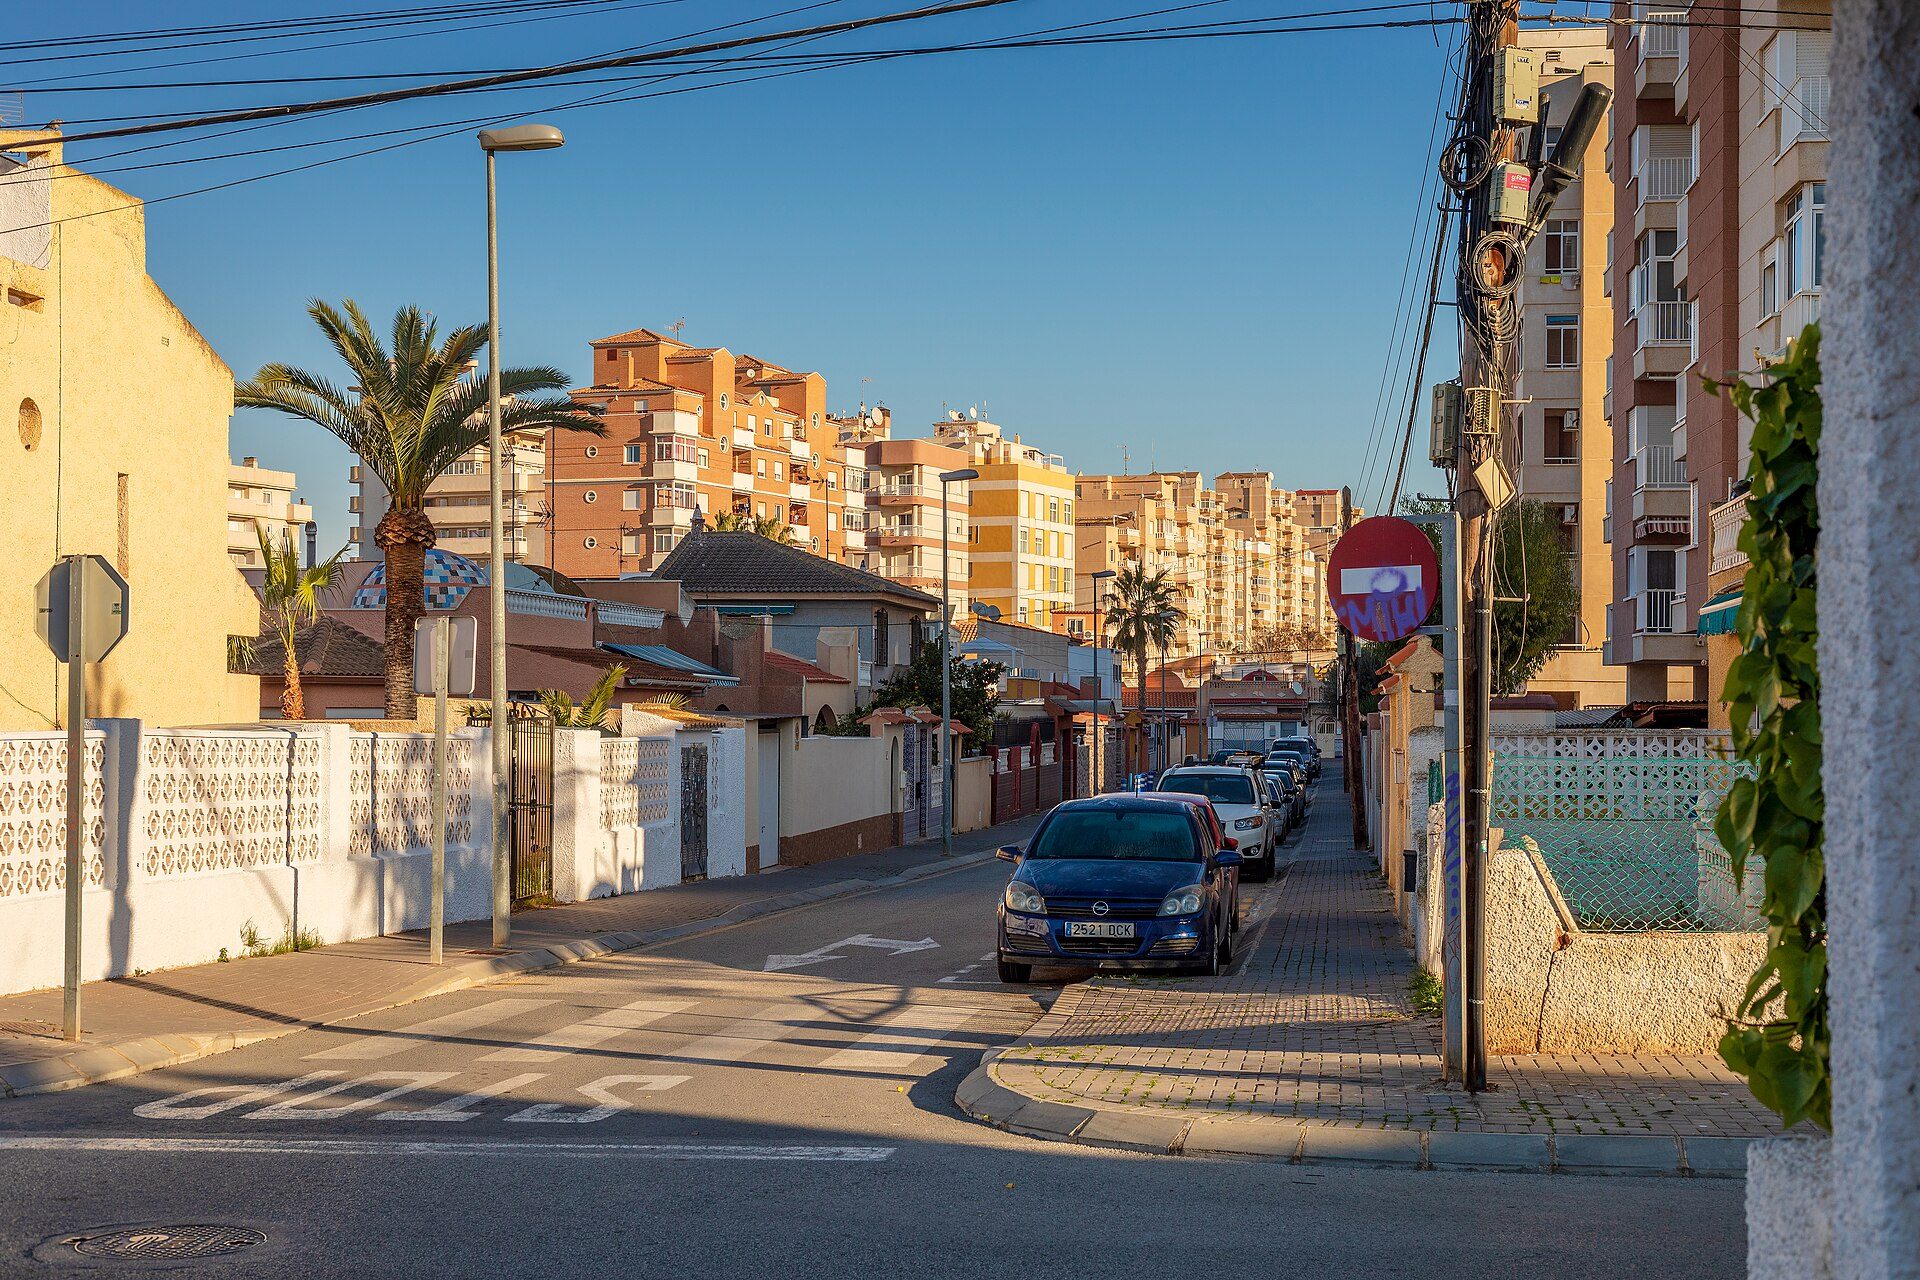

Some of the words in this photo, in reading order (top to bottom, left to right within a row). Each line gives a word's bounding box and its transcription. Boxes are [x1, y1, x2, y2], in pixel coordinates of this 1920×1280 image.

[1073, 924, 1102, 936] 2521
[1108, 924, 1132, 936] DCK
[133, 1069, 694, 1123] STOP
